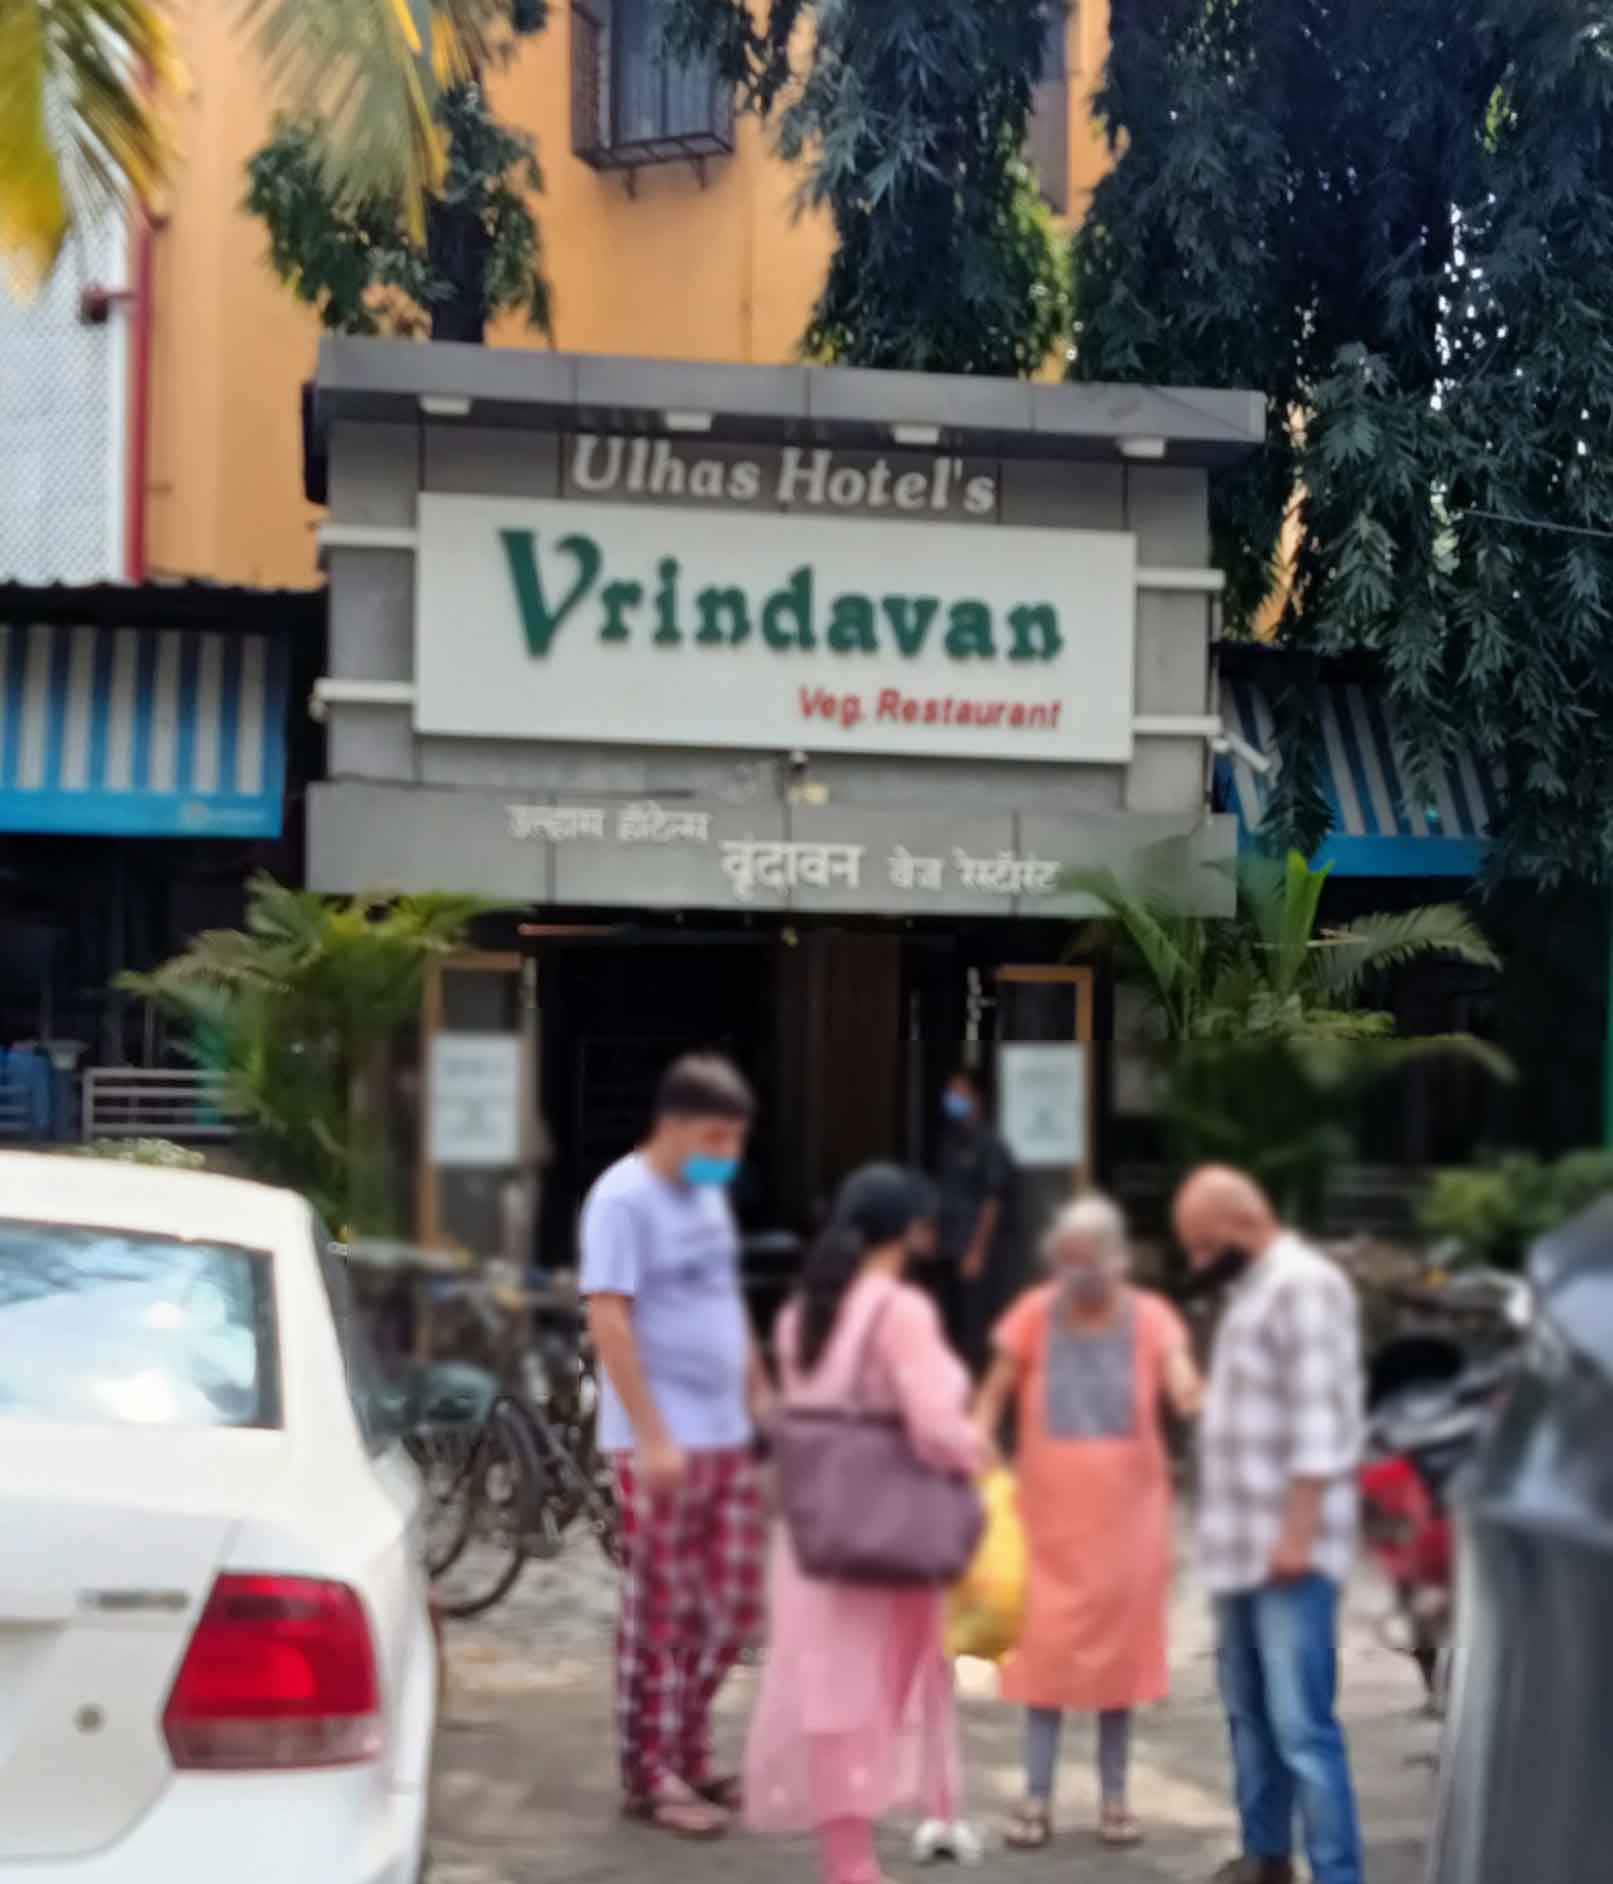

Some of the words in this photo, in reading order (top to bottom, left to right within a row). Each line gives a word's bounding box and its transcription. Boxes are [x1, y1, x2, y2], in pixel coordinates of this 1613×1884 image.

[571, 433, 761, 498] Ulhas
[776, 446, 998, 513] Hotel's
[498, 528, 1064, 662] Vrindavan
[799, 685, 864, 729] Veg.
[876, 687, 1064, 730] Restaurant
